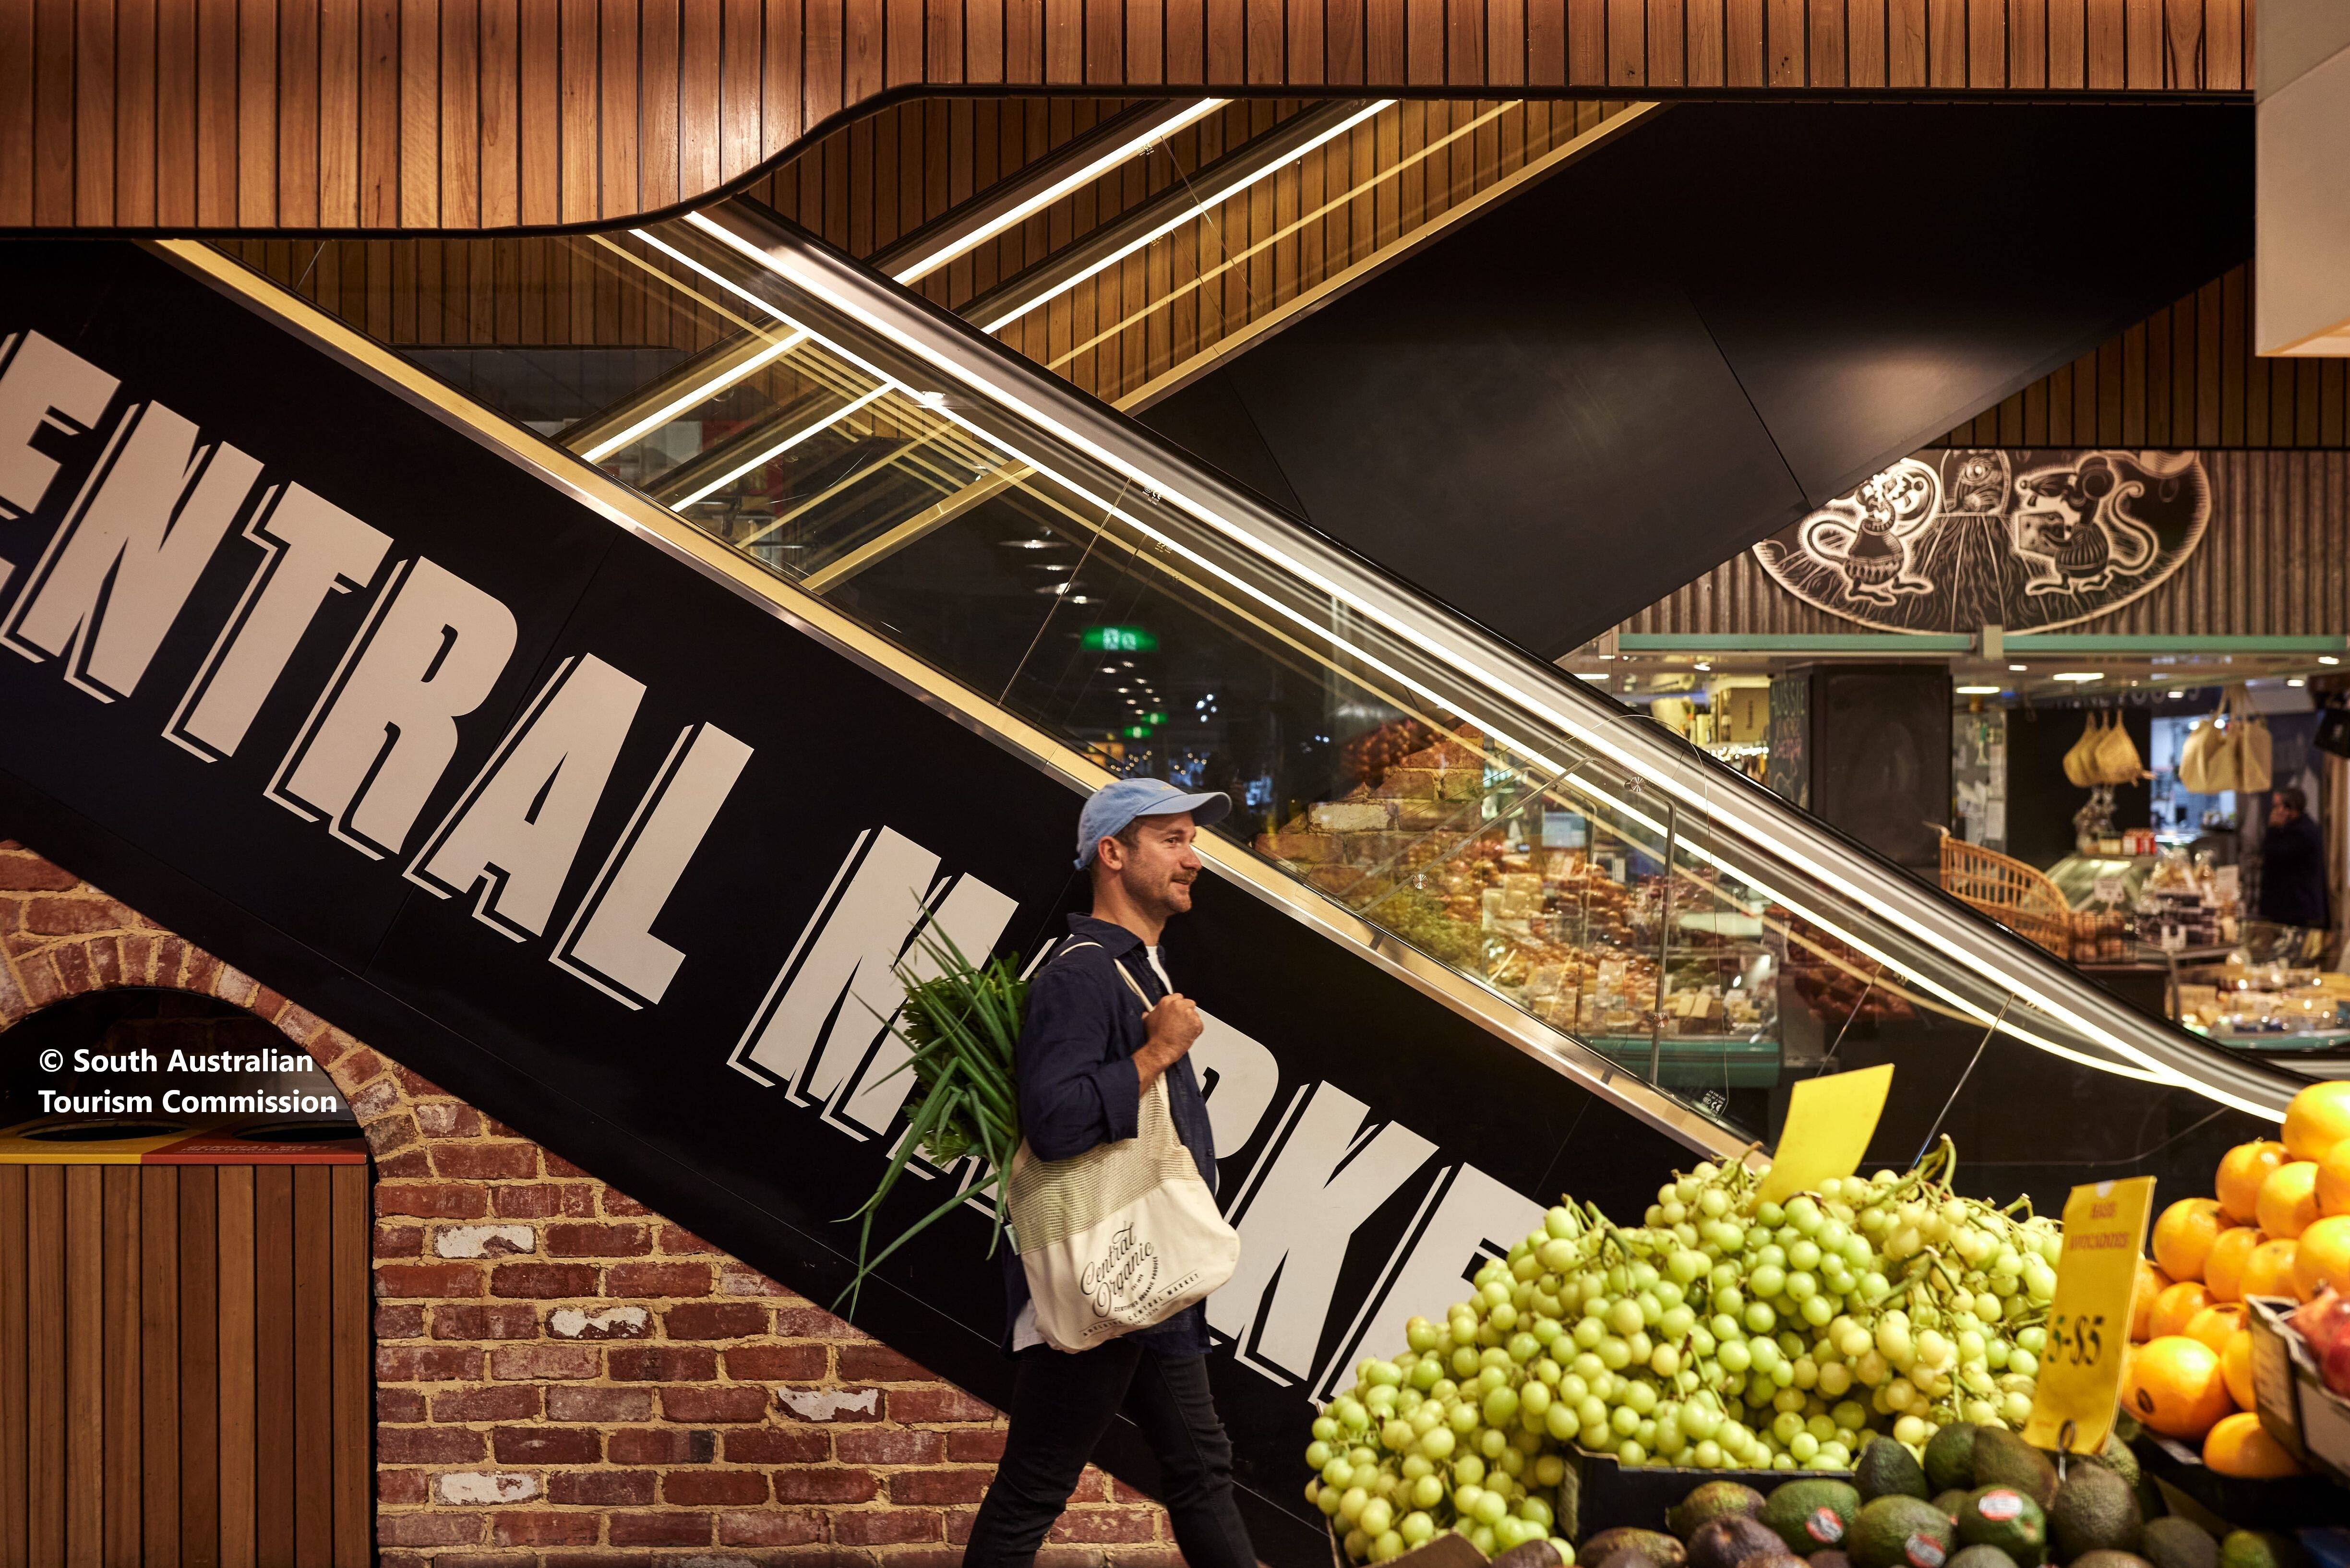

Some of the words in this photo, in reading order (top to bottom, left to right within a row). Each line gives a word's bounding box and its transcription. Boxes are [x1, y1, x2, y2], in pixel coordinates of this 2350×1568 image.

[1080, 1221, 1137, 1295] Central
[1092, 1242, 1154, 1317] Organic
[1128, 1296, 1163, 1321] CENTRAL
[1167, 1273, 1199, 1296] MARKET
[1139, 1281, 1154, 1301] ORGANIC
